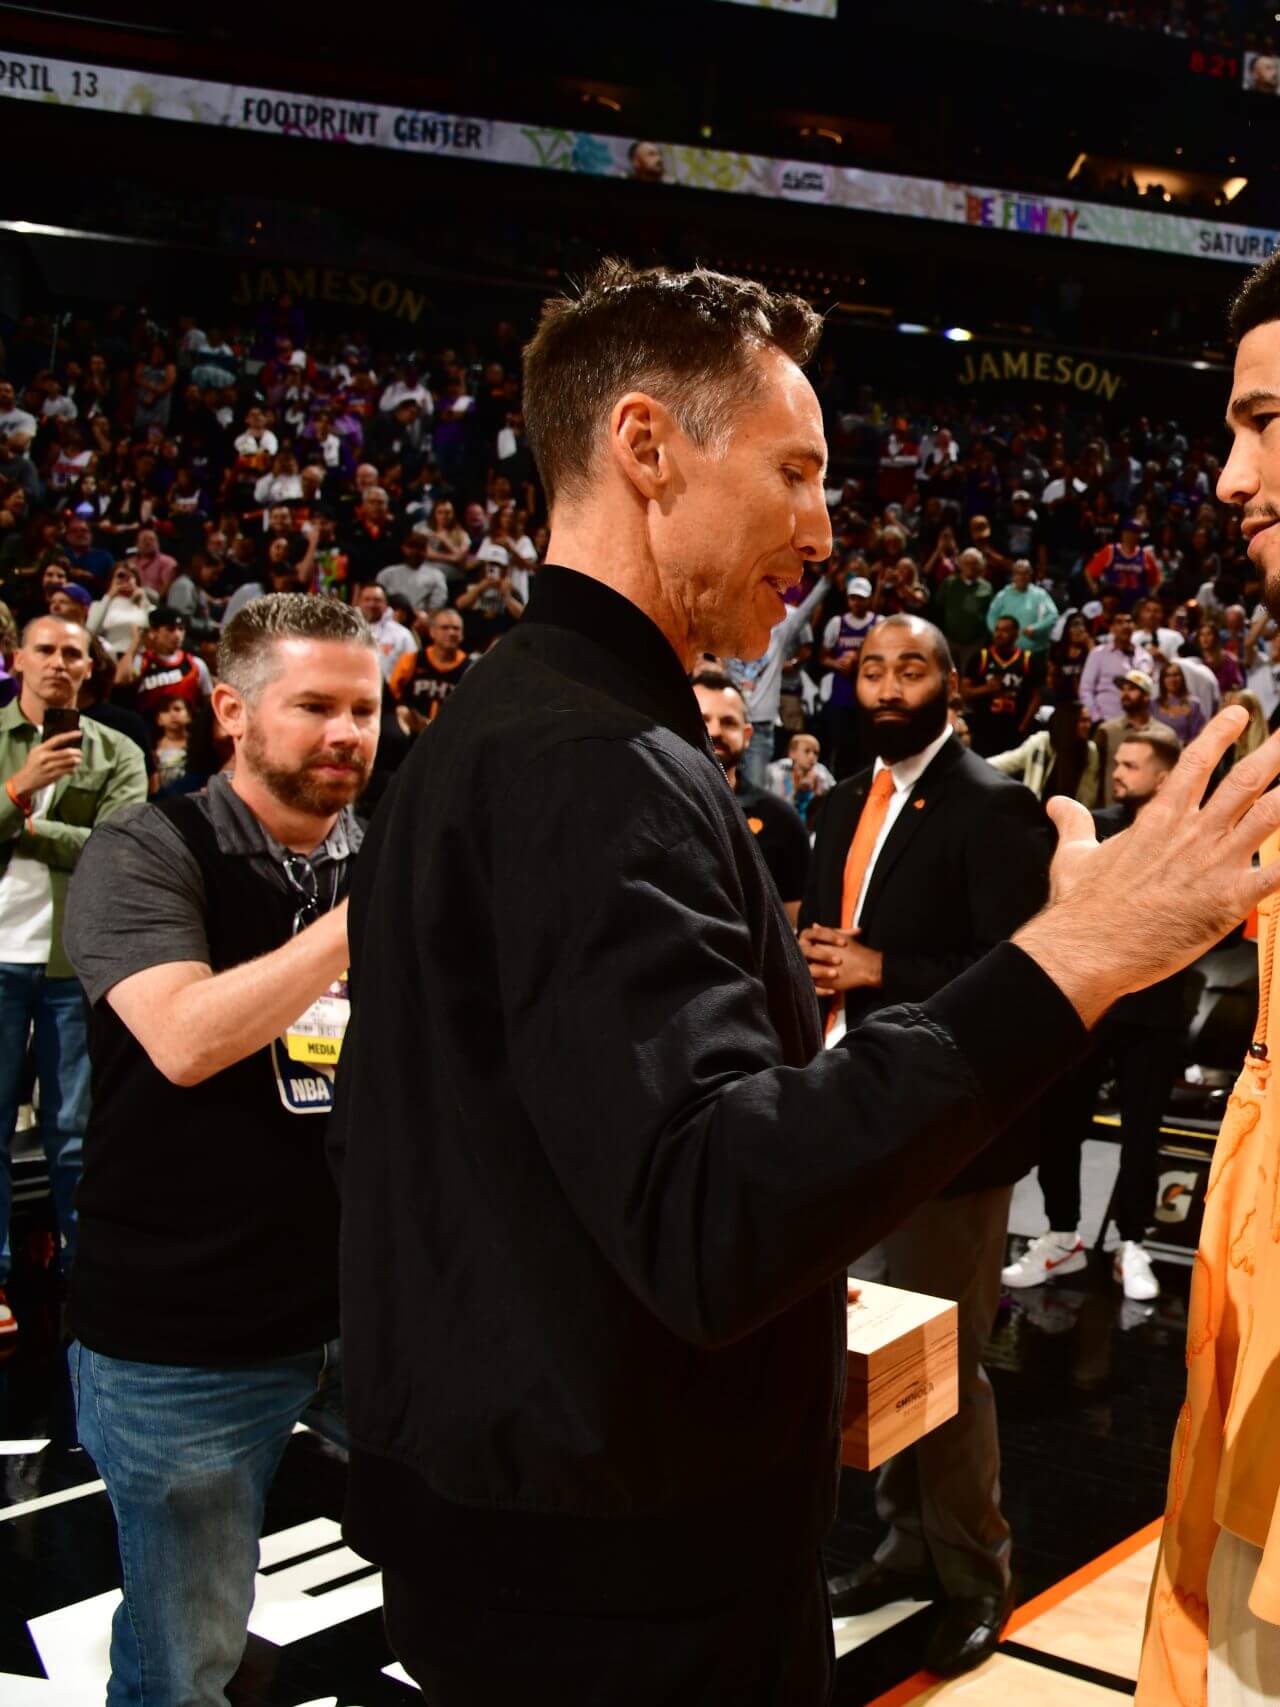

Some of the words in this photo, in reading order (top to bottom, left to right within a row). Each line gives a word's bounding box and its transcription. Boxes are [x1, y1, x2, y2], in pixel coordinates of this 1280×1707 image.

[72, 70, 98, 98] 13
[243, 97, 379, 138] FOOTPRINT
[394, 114, 482, 150] CENTER
[965, 190, 996, 228] BE
[1003, 198, 1078, 238] FUNNY
[1200, 229, 1277, 257] SATURD
[231, 266, 427, 325] JAMESON
[958, 350, 1121, 400] JAMESON
[308, 1043, 336, 1056] MEDIA
[291, 1077, 331, 1103] NBA
[1154, 1169, 1199, 1223] G
